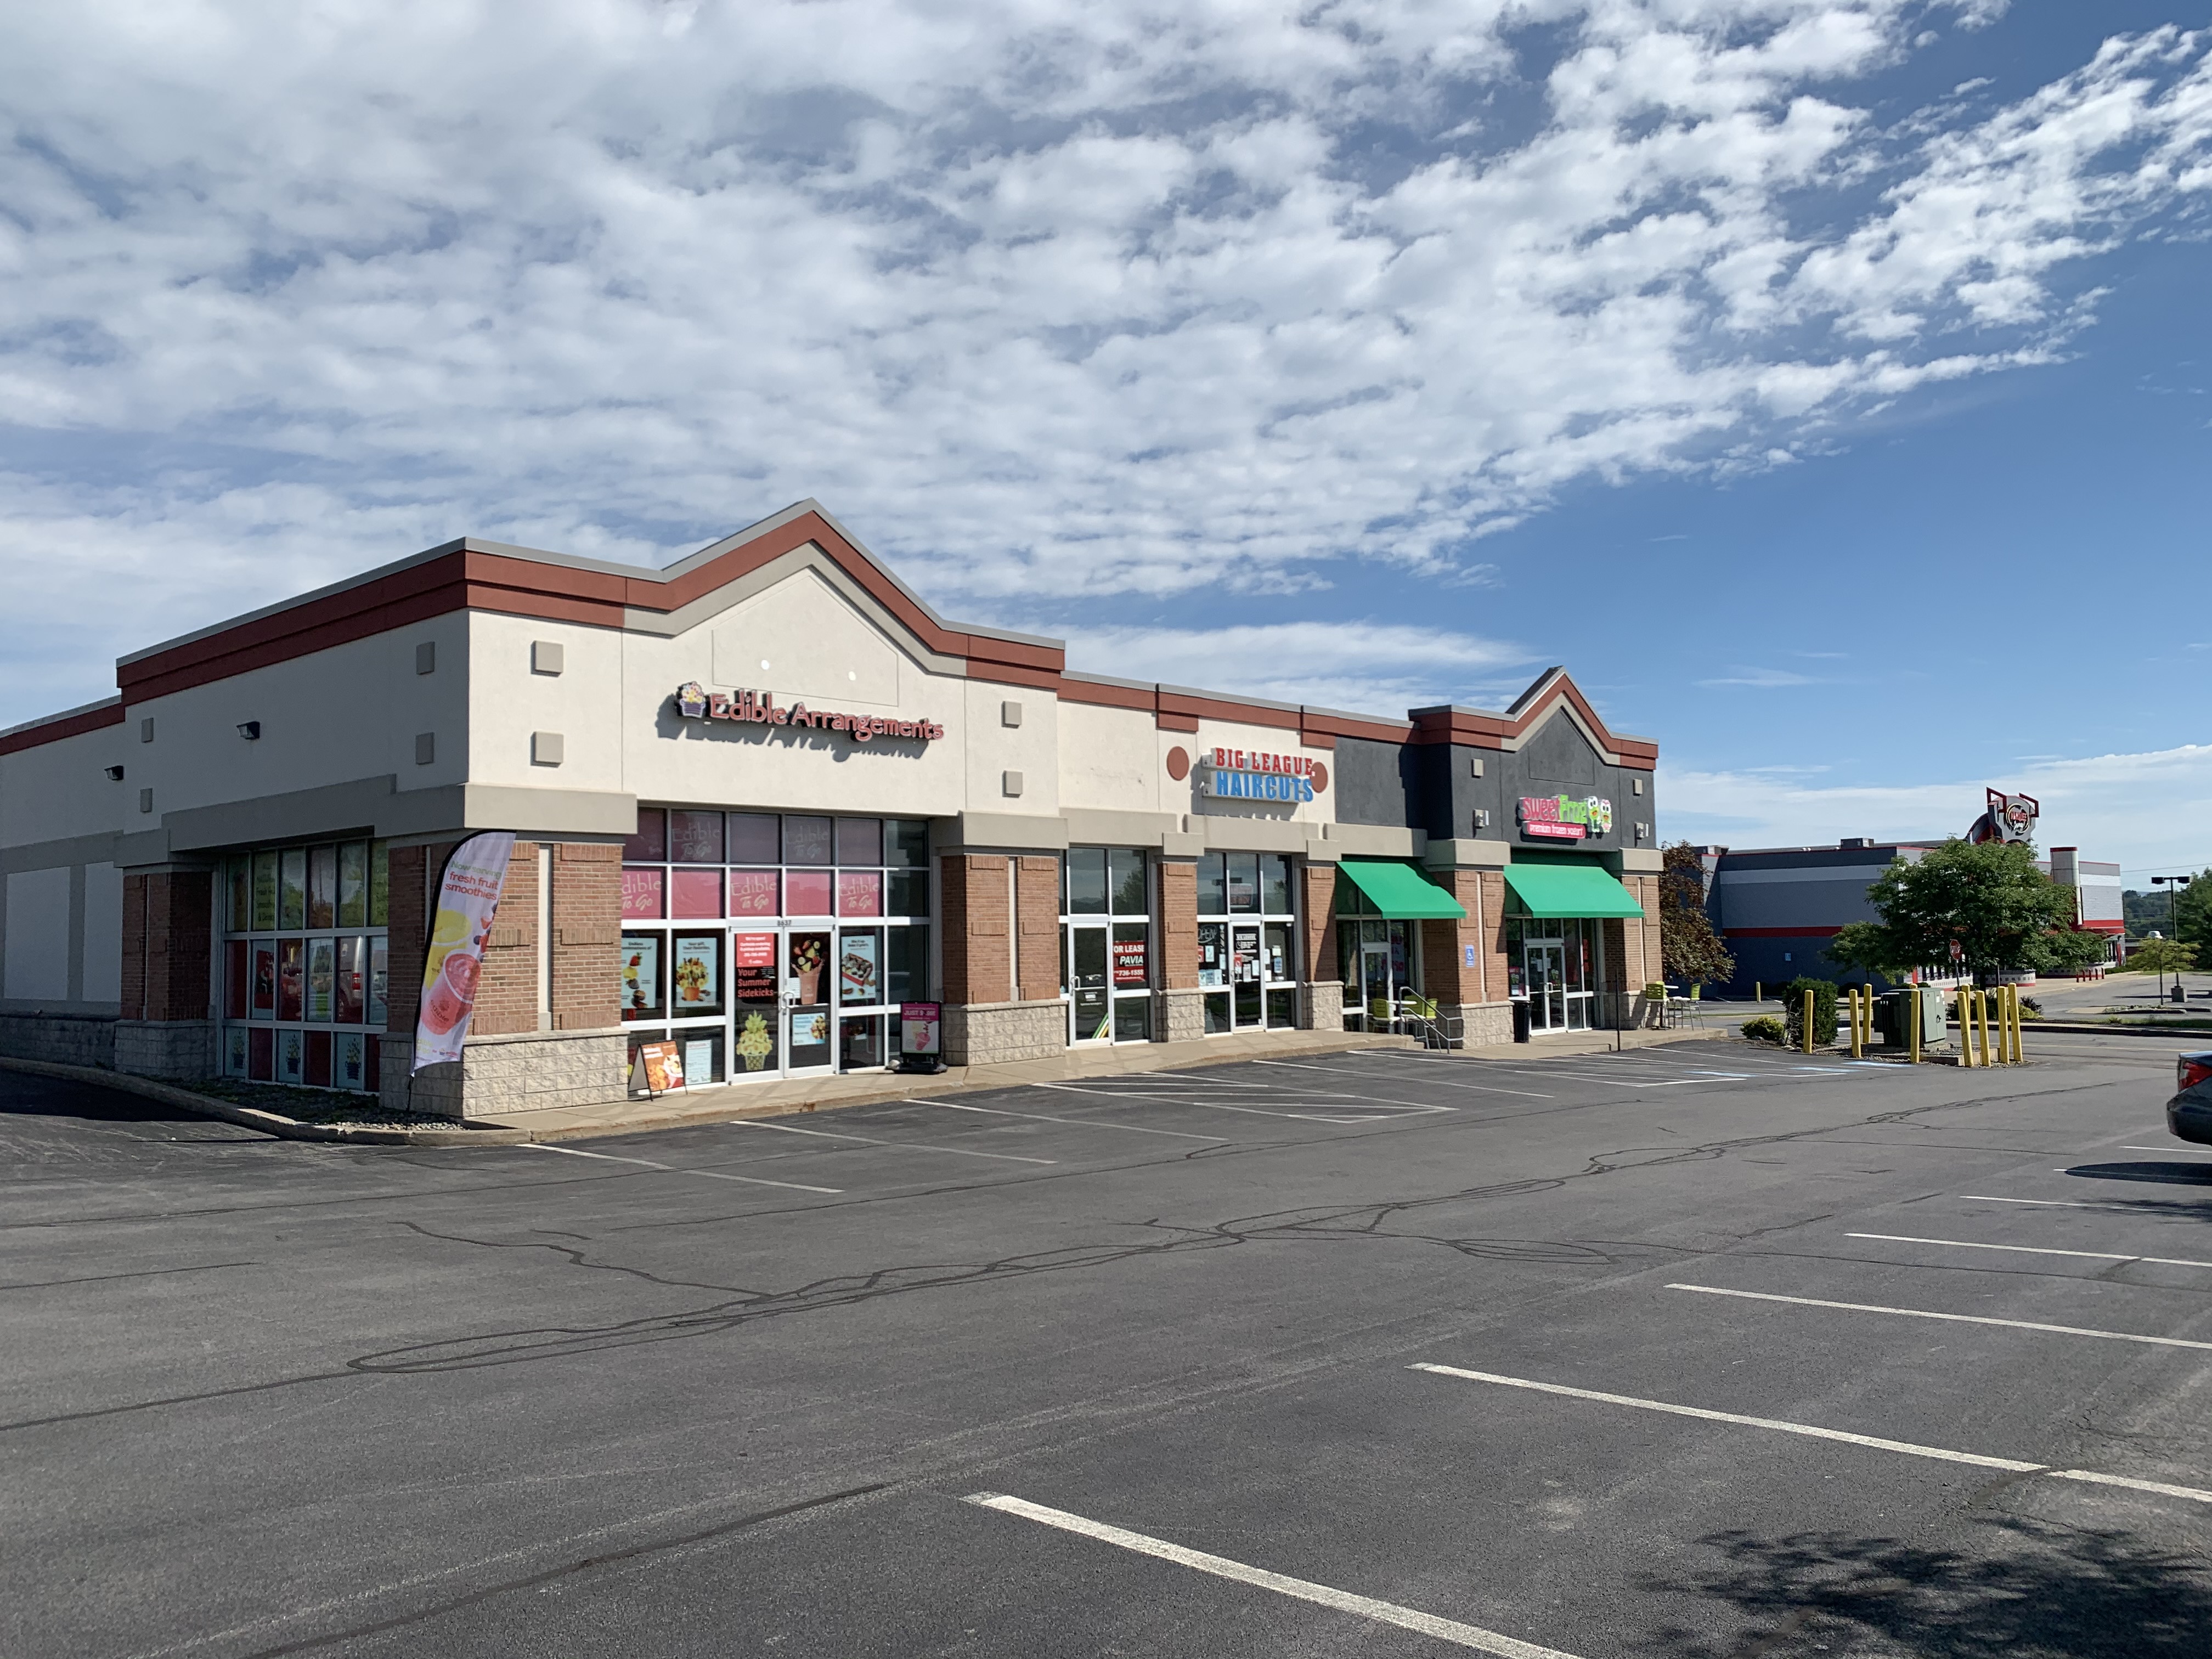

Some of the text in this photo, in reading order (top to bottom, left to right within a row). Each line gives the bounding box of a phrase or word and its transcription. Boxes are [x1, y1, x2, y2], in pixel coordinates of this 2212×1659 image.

[709, 688, 944, 742] Edible Arrangements
[1215, 747, 1313, 775] BIG LEAGUE
[1216, 771, 1314, 802] HAIRCUTS
[672, 822, 721, 842] Edible
[786, 825, 828, 844] Edible
[451, 860, 503, 880] Now serving
[450, 871, 498, 890] fresh fruit
[622, 873, 661, 894] dible
[731, 875, 776, 896] Edible
[839, 876, 879, 896] Edible
[445, 883, 498, 900] smoothies
[622, 894, 653, 911] To Go
[740, 894, 769, 911] To Go
[848, 895, 873, 910] To Go
[1125, 945, 1144, 953] LEASE
[1950, 945, 1961, 953] STOP
[1120, 956, 1143, 965] PAVIA
[738, 968, 757, 977] Your
[737, 978, 771, 987] Summer
[737, 988, 774, 997] Sidekicks
